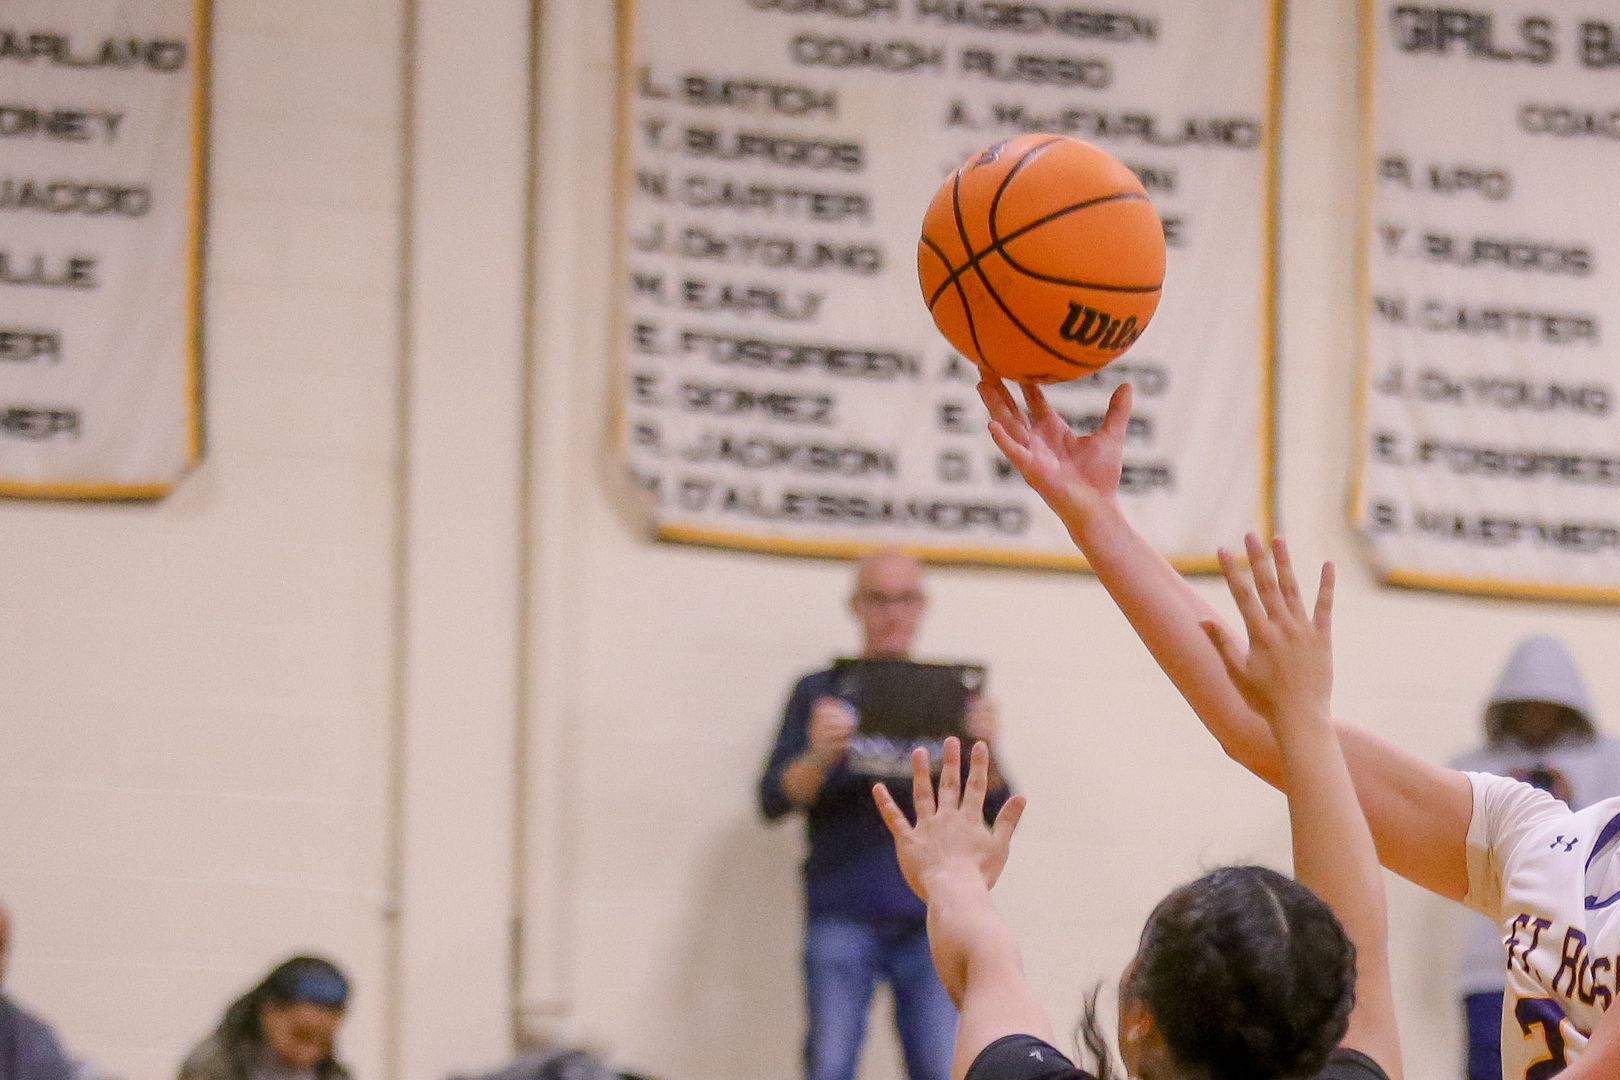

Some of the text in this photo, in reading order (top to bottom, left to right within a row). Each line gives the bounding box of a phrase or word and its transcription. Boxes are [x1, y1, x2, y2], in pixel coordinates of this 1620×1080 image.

[1390, 2, 1558, 66] GIRLS
[790, 31, 1113, 88] COACH RUSSO
[681, 72, 837, 116] BATCH
[681, 122, 866, 171] BURGOS
[681, 173, 871, 219] CARTER
[1421, 229, 1596, 276] BURGOS
[680, 275, 829, 320] EARLY
[1417, 297, 1600, 344] CARTER
